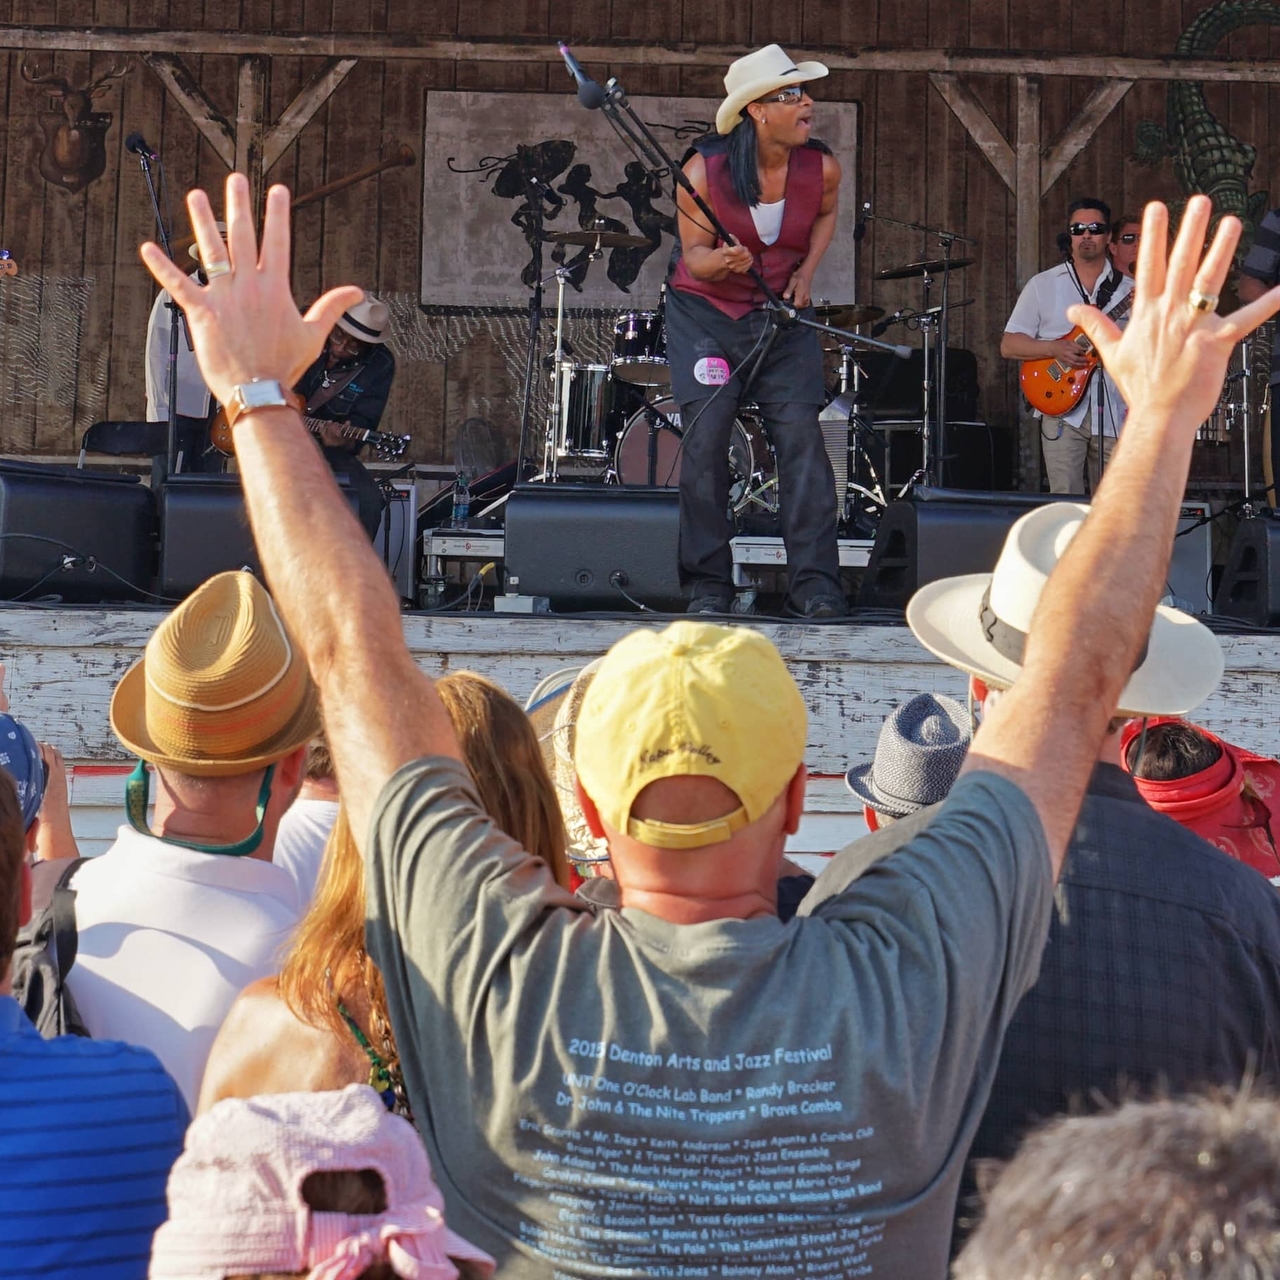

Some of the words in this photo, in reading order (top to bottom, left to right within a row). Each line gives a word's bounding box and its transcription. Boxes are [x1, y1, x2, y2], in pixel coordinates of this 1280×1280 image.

[569, 1038, 606, 1058] 2015
[609, 1043, 663, 1068] Denton
[666, 1052, 701, 1070] Arts
[704, 1055, 731, 1072] and
[735, 1053, 770, 1070] Jazz
[774, 1043, 832, 1065] Festival
[562, 1072, 592, 1088] UNT
[594, 1077, 620, 1093] One
[623, 1082, 671, 1099] O'Clock
[673, 1088, 696, 1103] Lab
[700, 1088, 732, 1103] Band
[745, 1082, 784, 1100] Randy
[787, 1079, 836, 1095] Brecker
[577, 1096, 612, 1113] John
[614, 1101, 624, 1114] &
[627, 1102, 653, 1118] The
[656, 1104, 686, 1120] Nite
[689, 1107, 746, 1125] Trippers
[760, 1103, 798, 1119] Brave
[800, 1099, 843, 1116] Combo
[681, 1139, 731, 1152] Anderson
[780, 1146, 830, 1161] Ensemble
